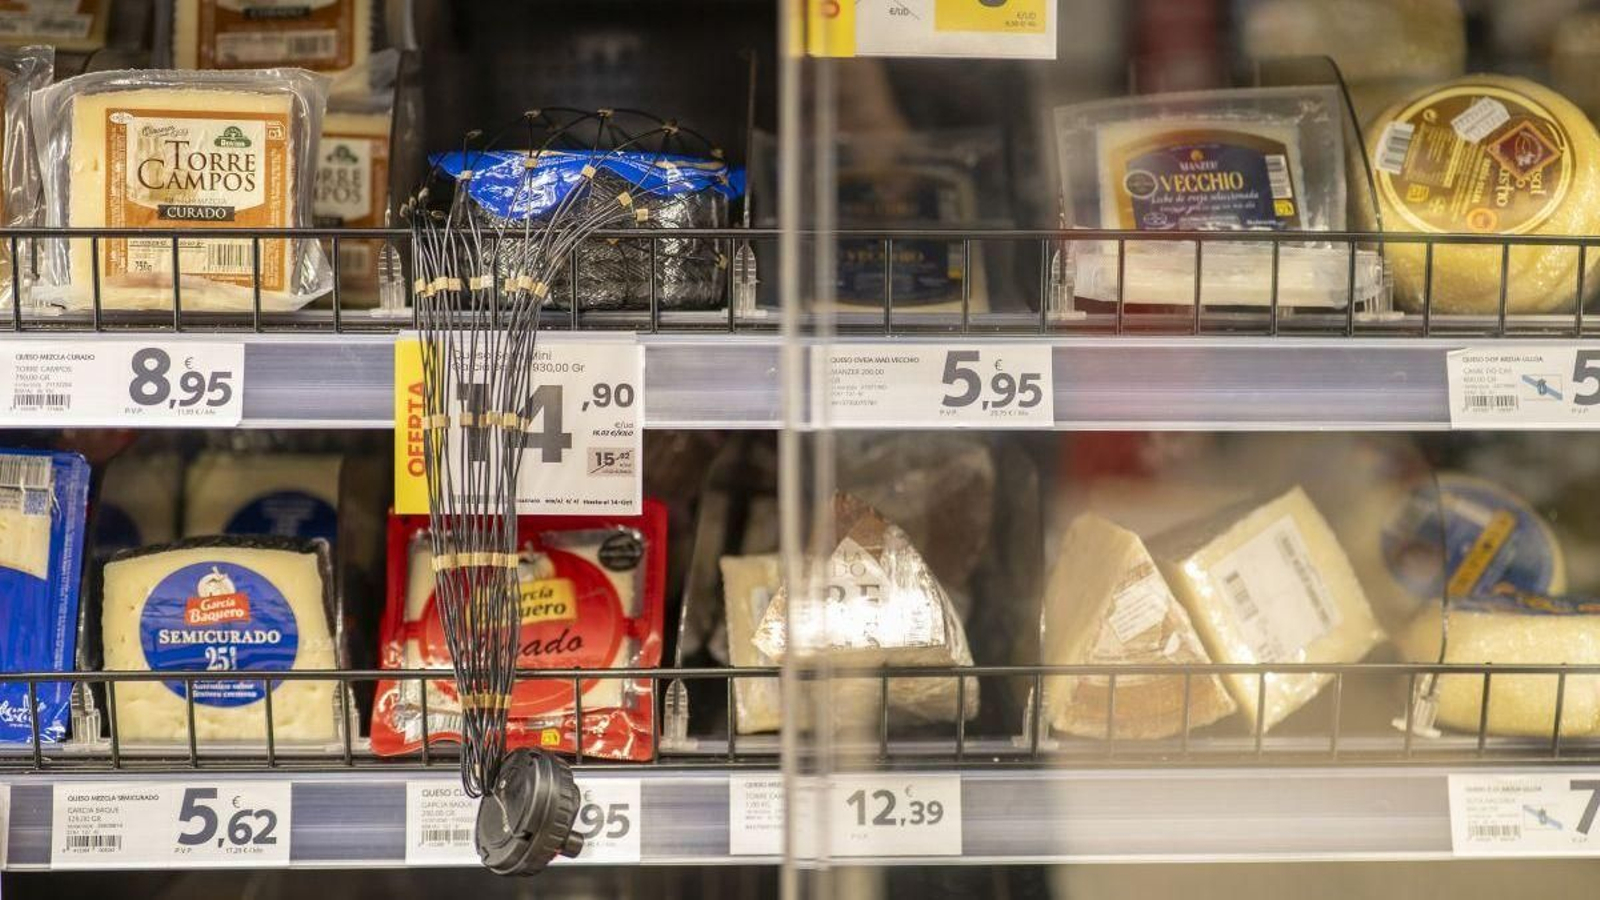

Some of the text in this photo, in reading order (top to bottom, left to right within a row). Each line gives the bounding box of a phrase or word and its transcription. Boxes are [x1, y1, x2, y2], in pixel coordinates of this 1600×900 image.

[165, 139, 256, 172] TORRE
[137, 157, 256, 192] CAMPOS
[1159, 171, 1244, 193] VECCHIO
[166, 207, 227, 219] CURADO
[184, 356, 195, 370] €
[532, 363, 569, 373] 930,00
[571, 363, 586, 372] Gr
[994, 359, 1004, 371] €
[128, 346, 233, 410] 8,95
[941, 350, 1044, 411] 5,95
[407, 380, 426, 478] OFERTA
[456, 383, 572, 464] 14
[188, 607, 245, 624] Baquero
[200, 597, 236, 612] García
[158, 629, 282, 645] SEMICURADO
[232, 795, 242, 809] €
[421, 788, 452, 798] QUESO
[177, 788, 278, 848] 5,62
[846, 789, 944, 827] 12,39
[579, 803, 631, 839] 95
